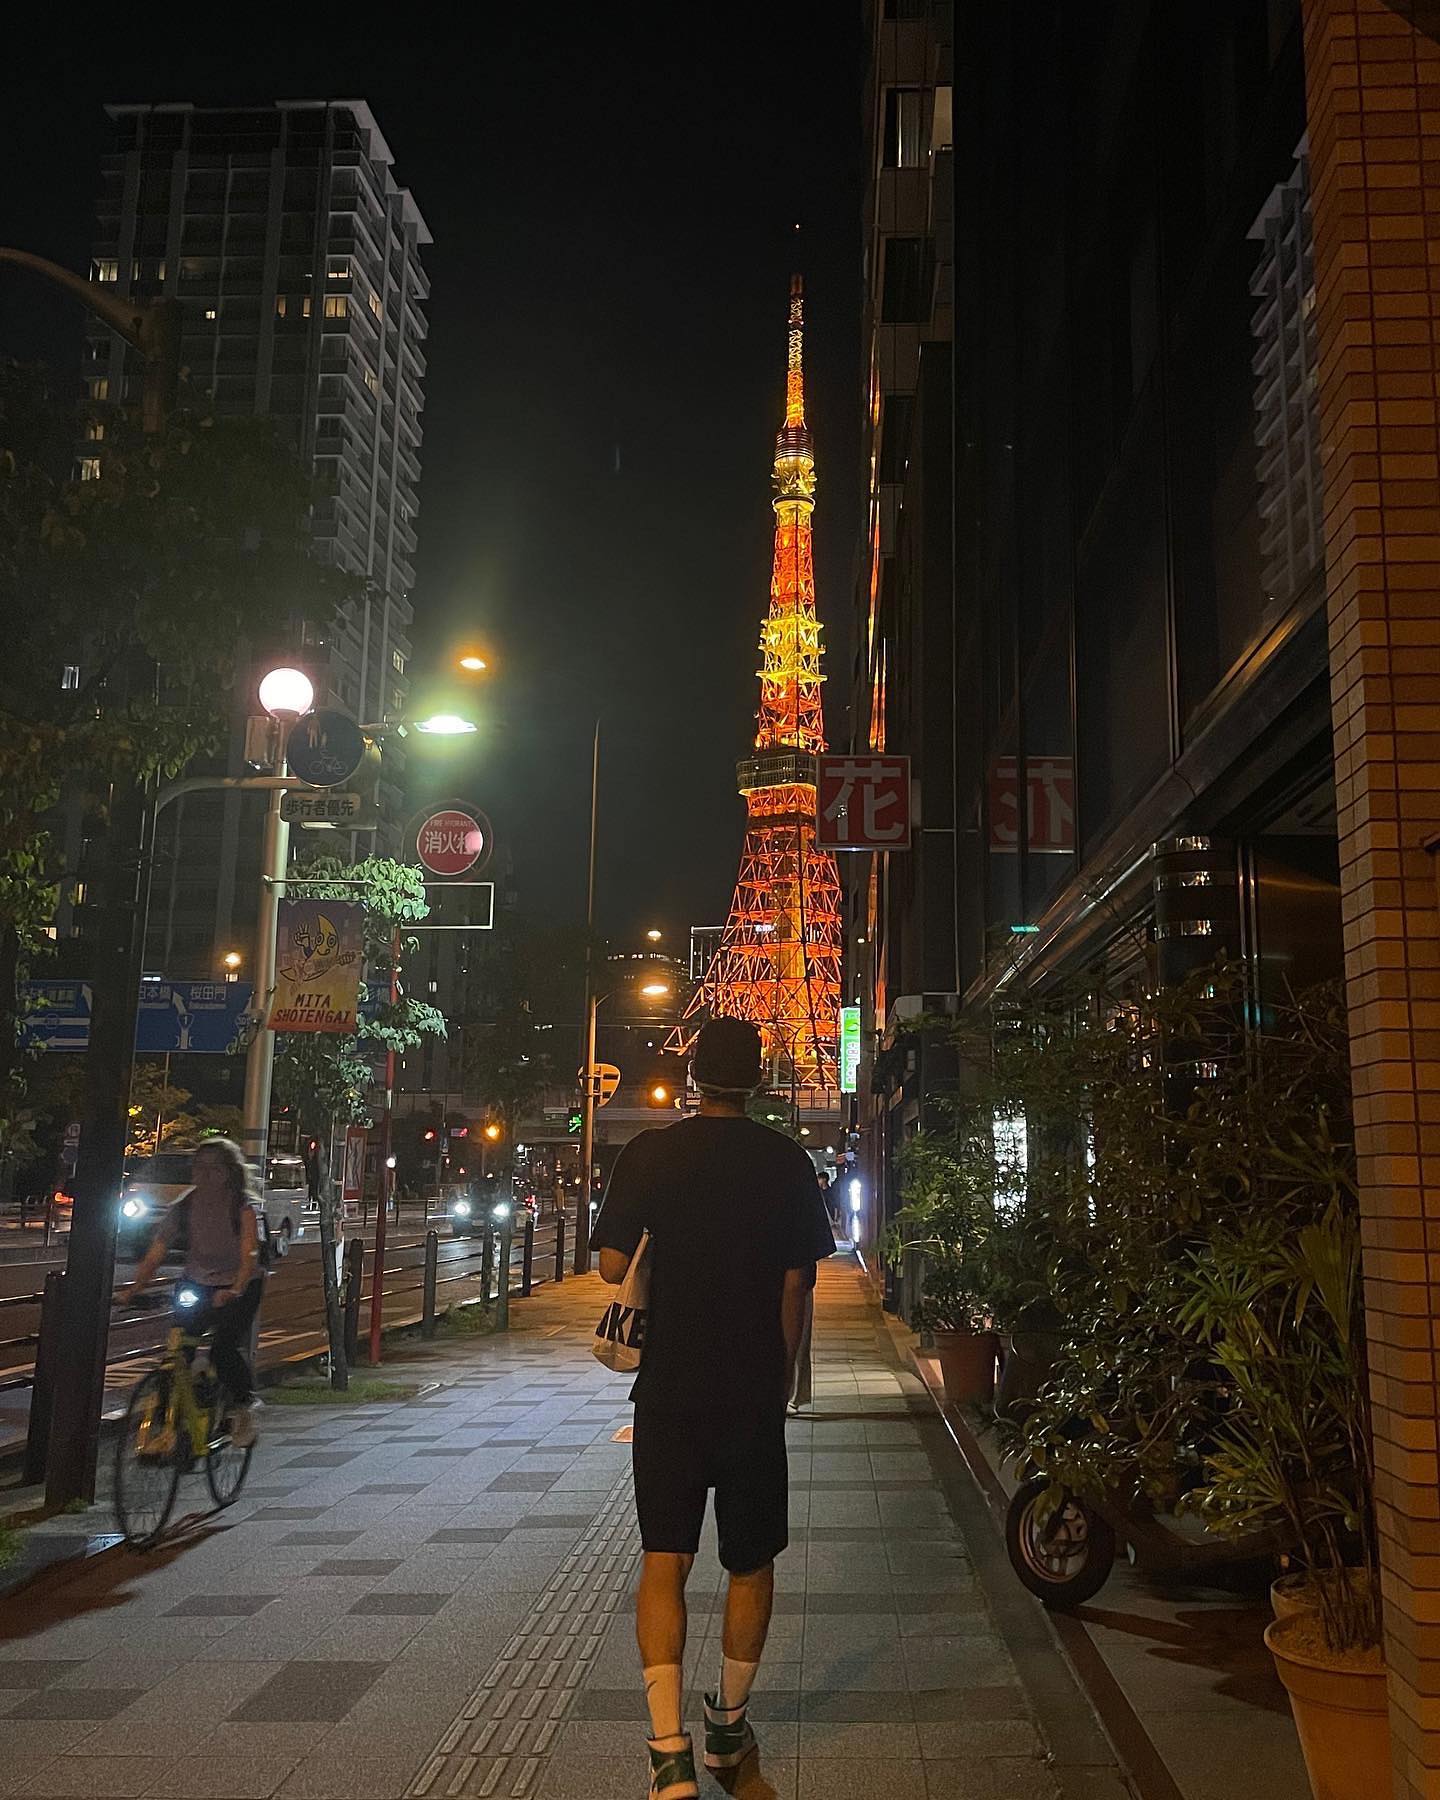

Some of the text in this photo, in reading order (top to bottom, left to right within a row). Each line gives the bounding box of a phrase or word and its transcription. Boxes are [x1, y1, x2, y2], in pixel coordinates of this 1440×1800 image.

[286, 799, 354, 816] 歩行者優先
[823, 760, 905, 841] 花
[295, 993, 331, 1009] MITA
[274, 1009, 351, 1024] SHOTENGAI
